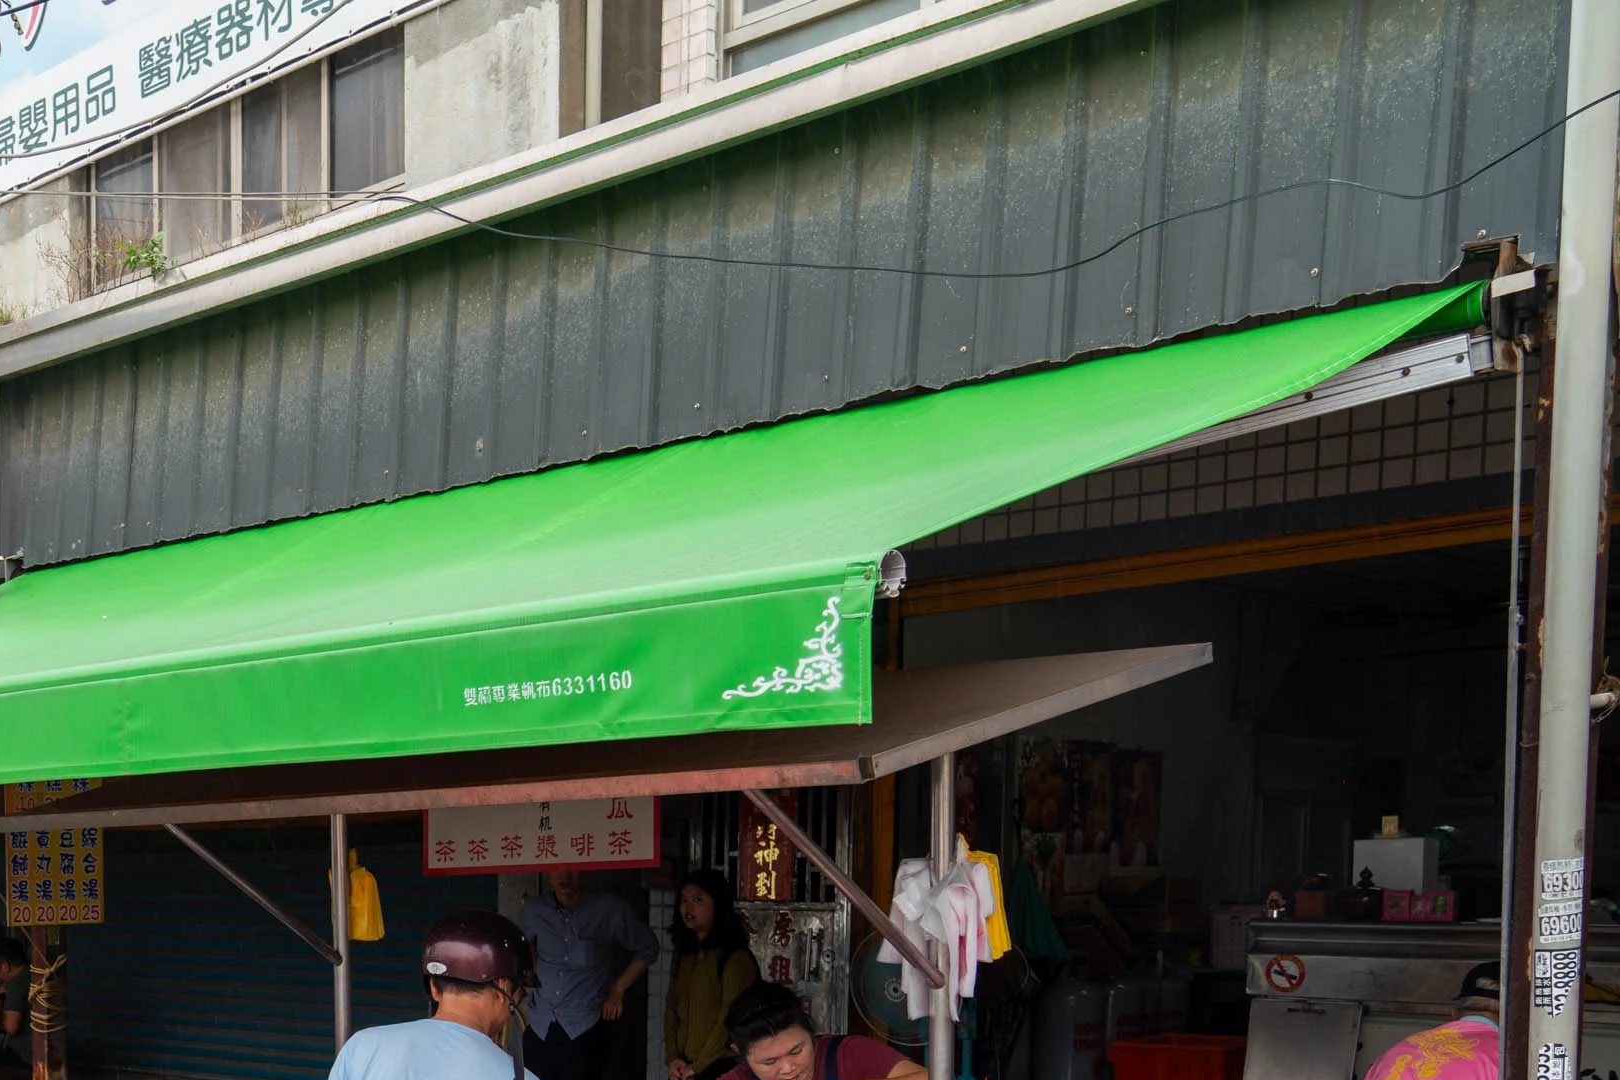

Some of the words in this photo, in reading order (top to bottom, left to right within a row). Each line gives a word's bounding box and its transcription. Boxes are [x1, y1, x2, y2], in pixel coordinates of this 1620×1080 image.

[12, 905, 32, 923] 20
[36, 905, 55, 923] 20
[59, 904, 78, 922] 20
[82, 904, 100, 921] 25
